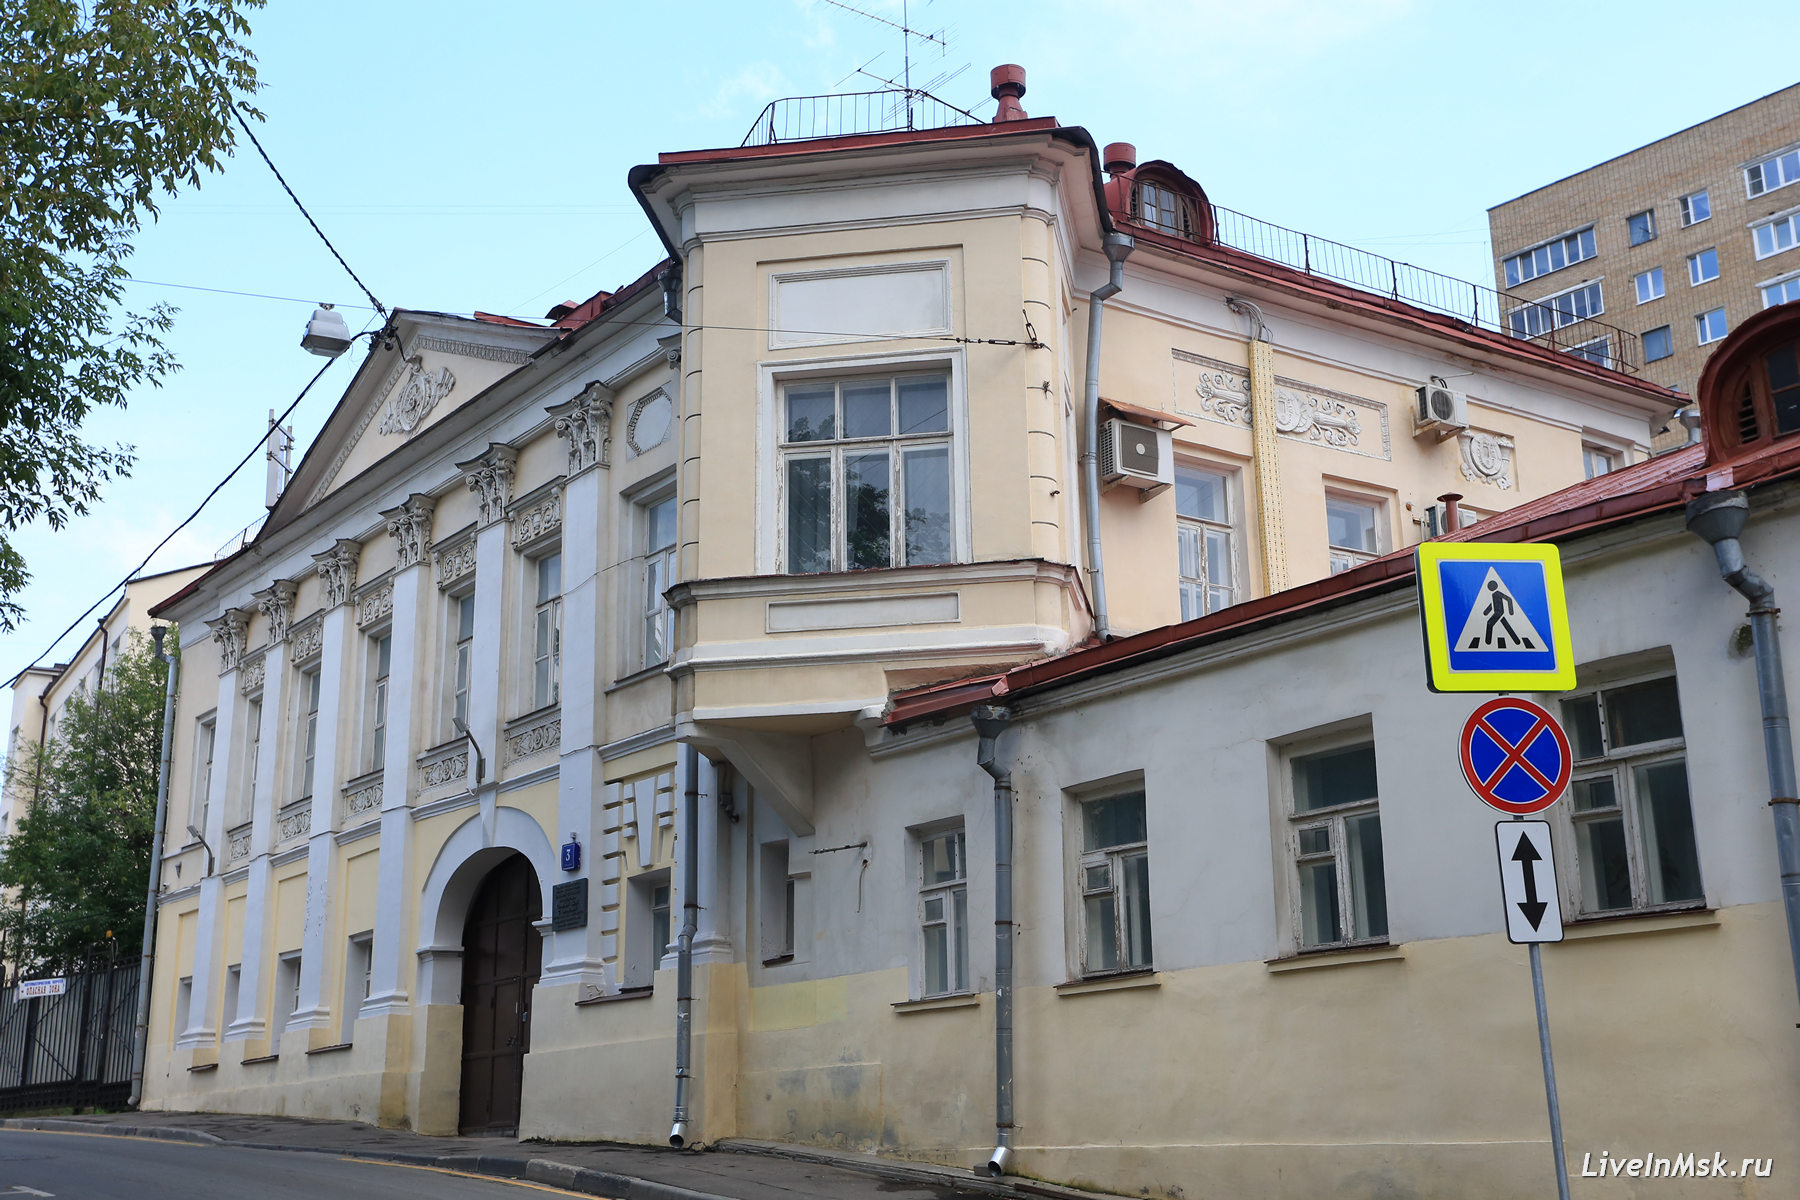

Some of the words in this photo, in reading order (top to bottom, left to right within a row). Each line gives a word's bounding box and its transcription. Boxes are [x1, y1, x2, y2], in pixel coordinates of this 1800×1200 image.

[565, 848, 571, 862] 3
[26, 985, 47, 996] ОПАСНАЯ
[49, 984, 60, 994] ЗОНА
